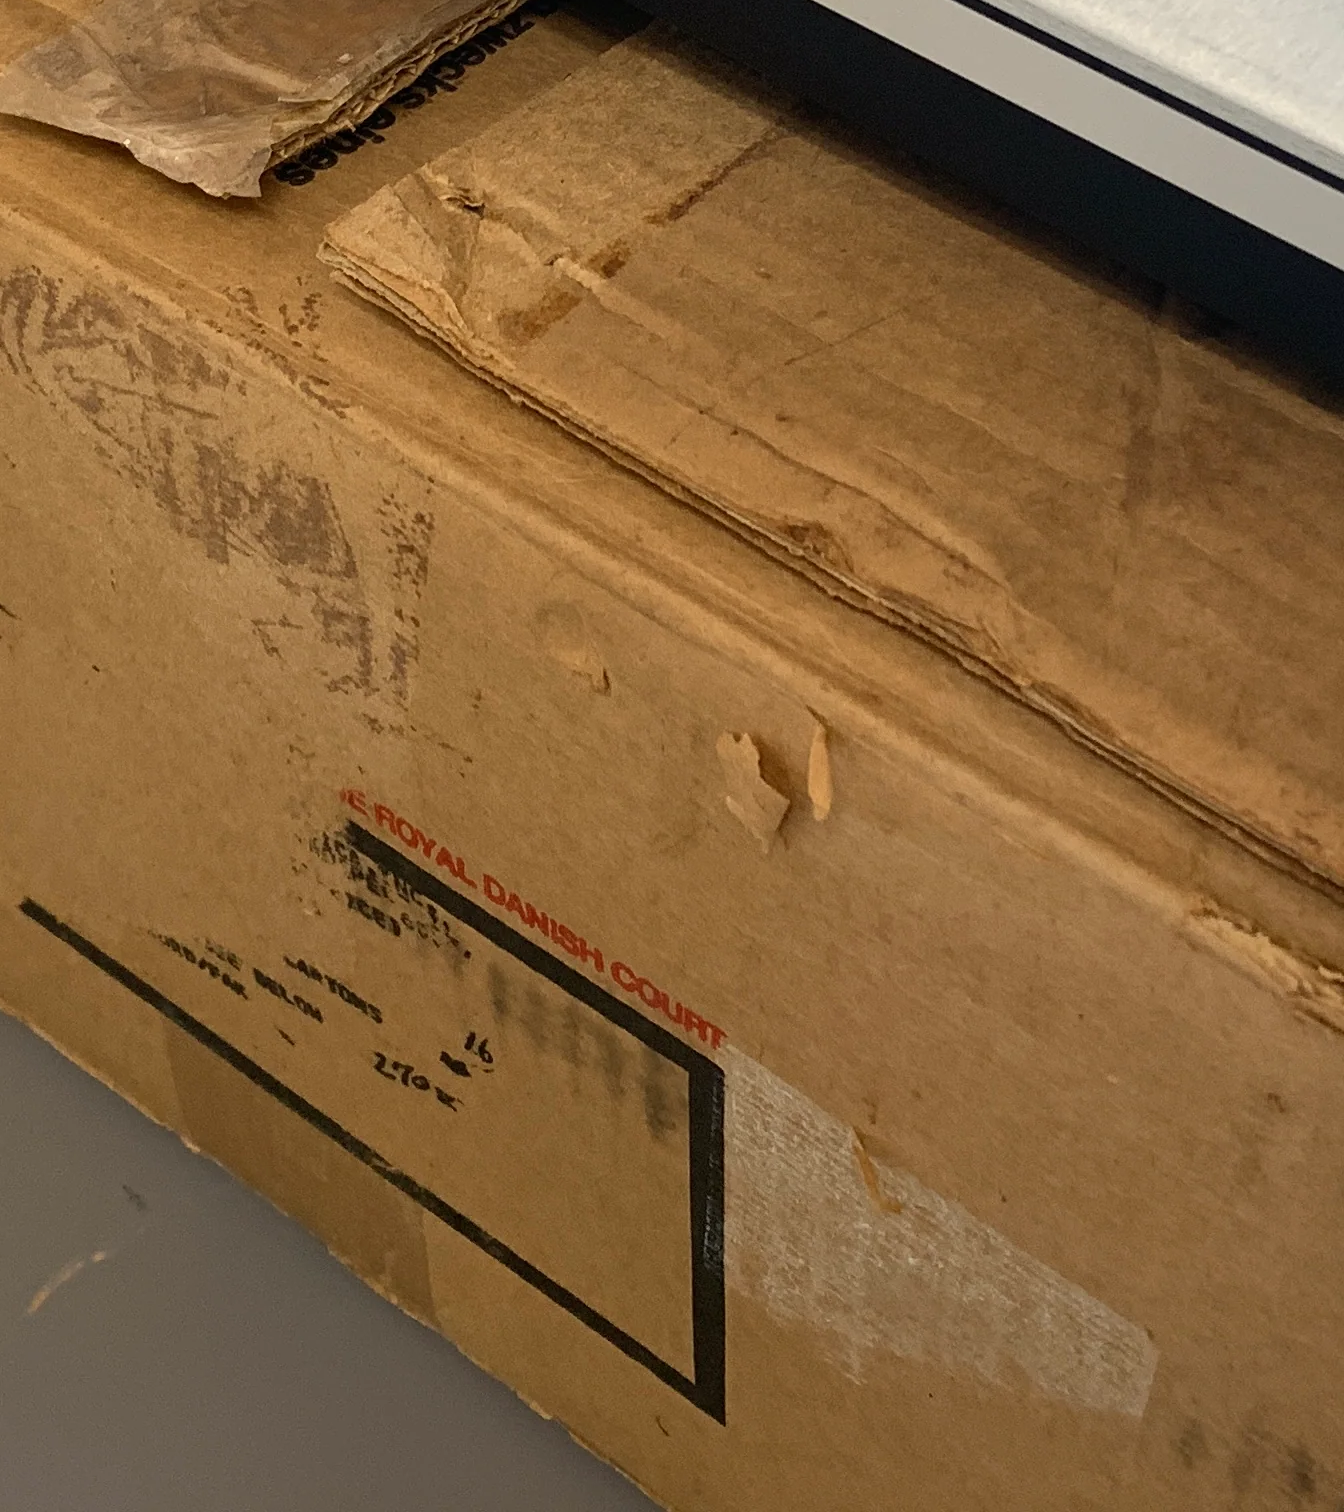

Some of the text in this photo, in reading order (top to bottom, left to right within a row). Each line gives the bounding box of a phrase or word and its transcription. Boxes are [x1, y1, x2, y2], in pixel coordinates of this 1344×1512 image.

[373, 801, 478, 890] ROYAL
[483, 873, 605, 974] DANISH
[610, 960, 729, 1051] COURT
